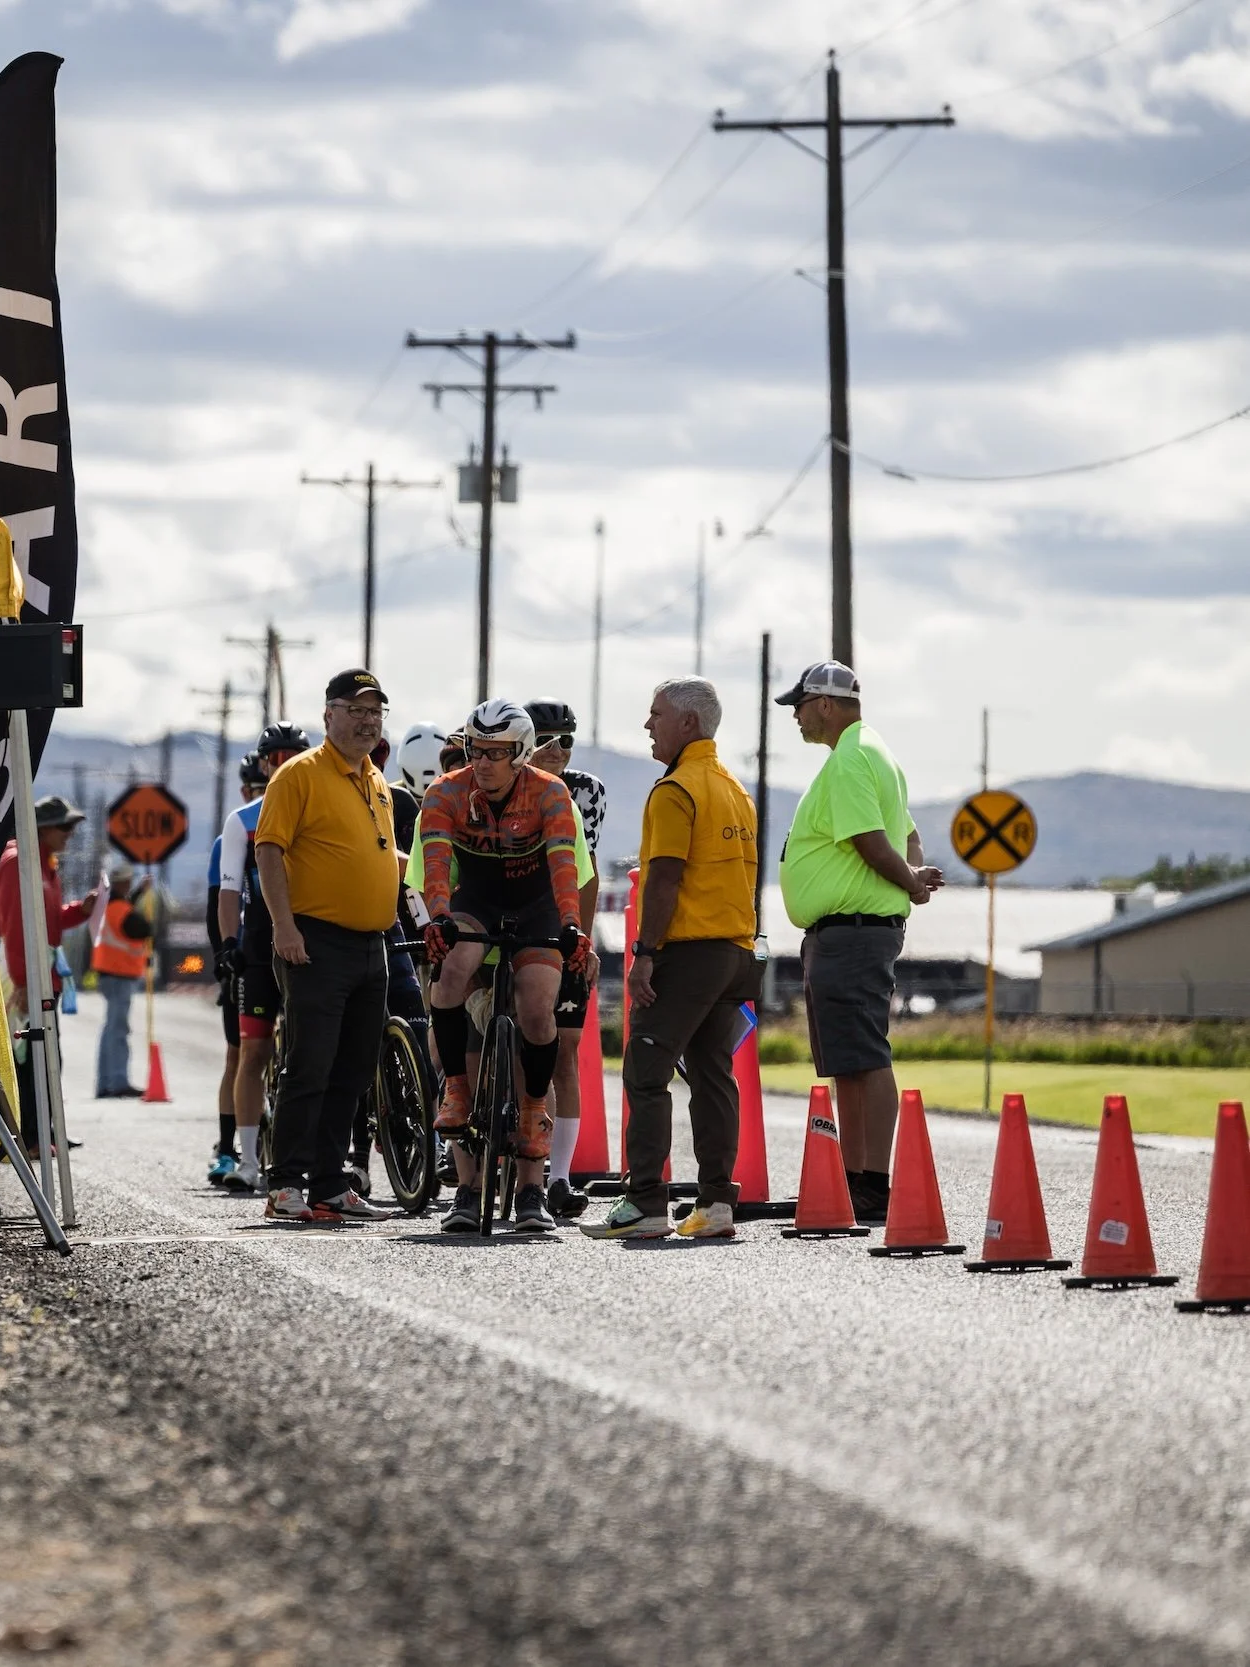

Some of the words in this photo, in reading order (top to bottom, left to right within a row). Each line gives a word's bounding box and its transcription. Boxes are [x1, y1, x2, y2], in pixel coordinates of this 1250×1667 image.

[121, 809, 175, 839] SLOW
[958, 821, 975, 842] R
[1013, 821, 1030, 842] R
